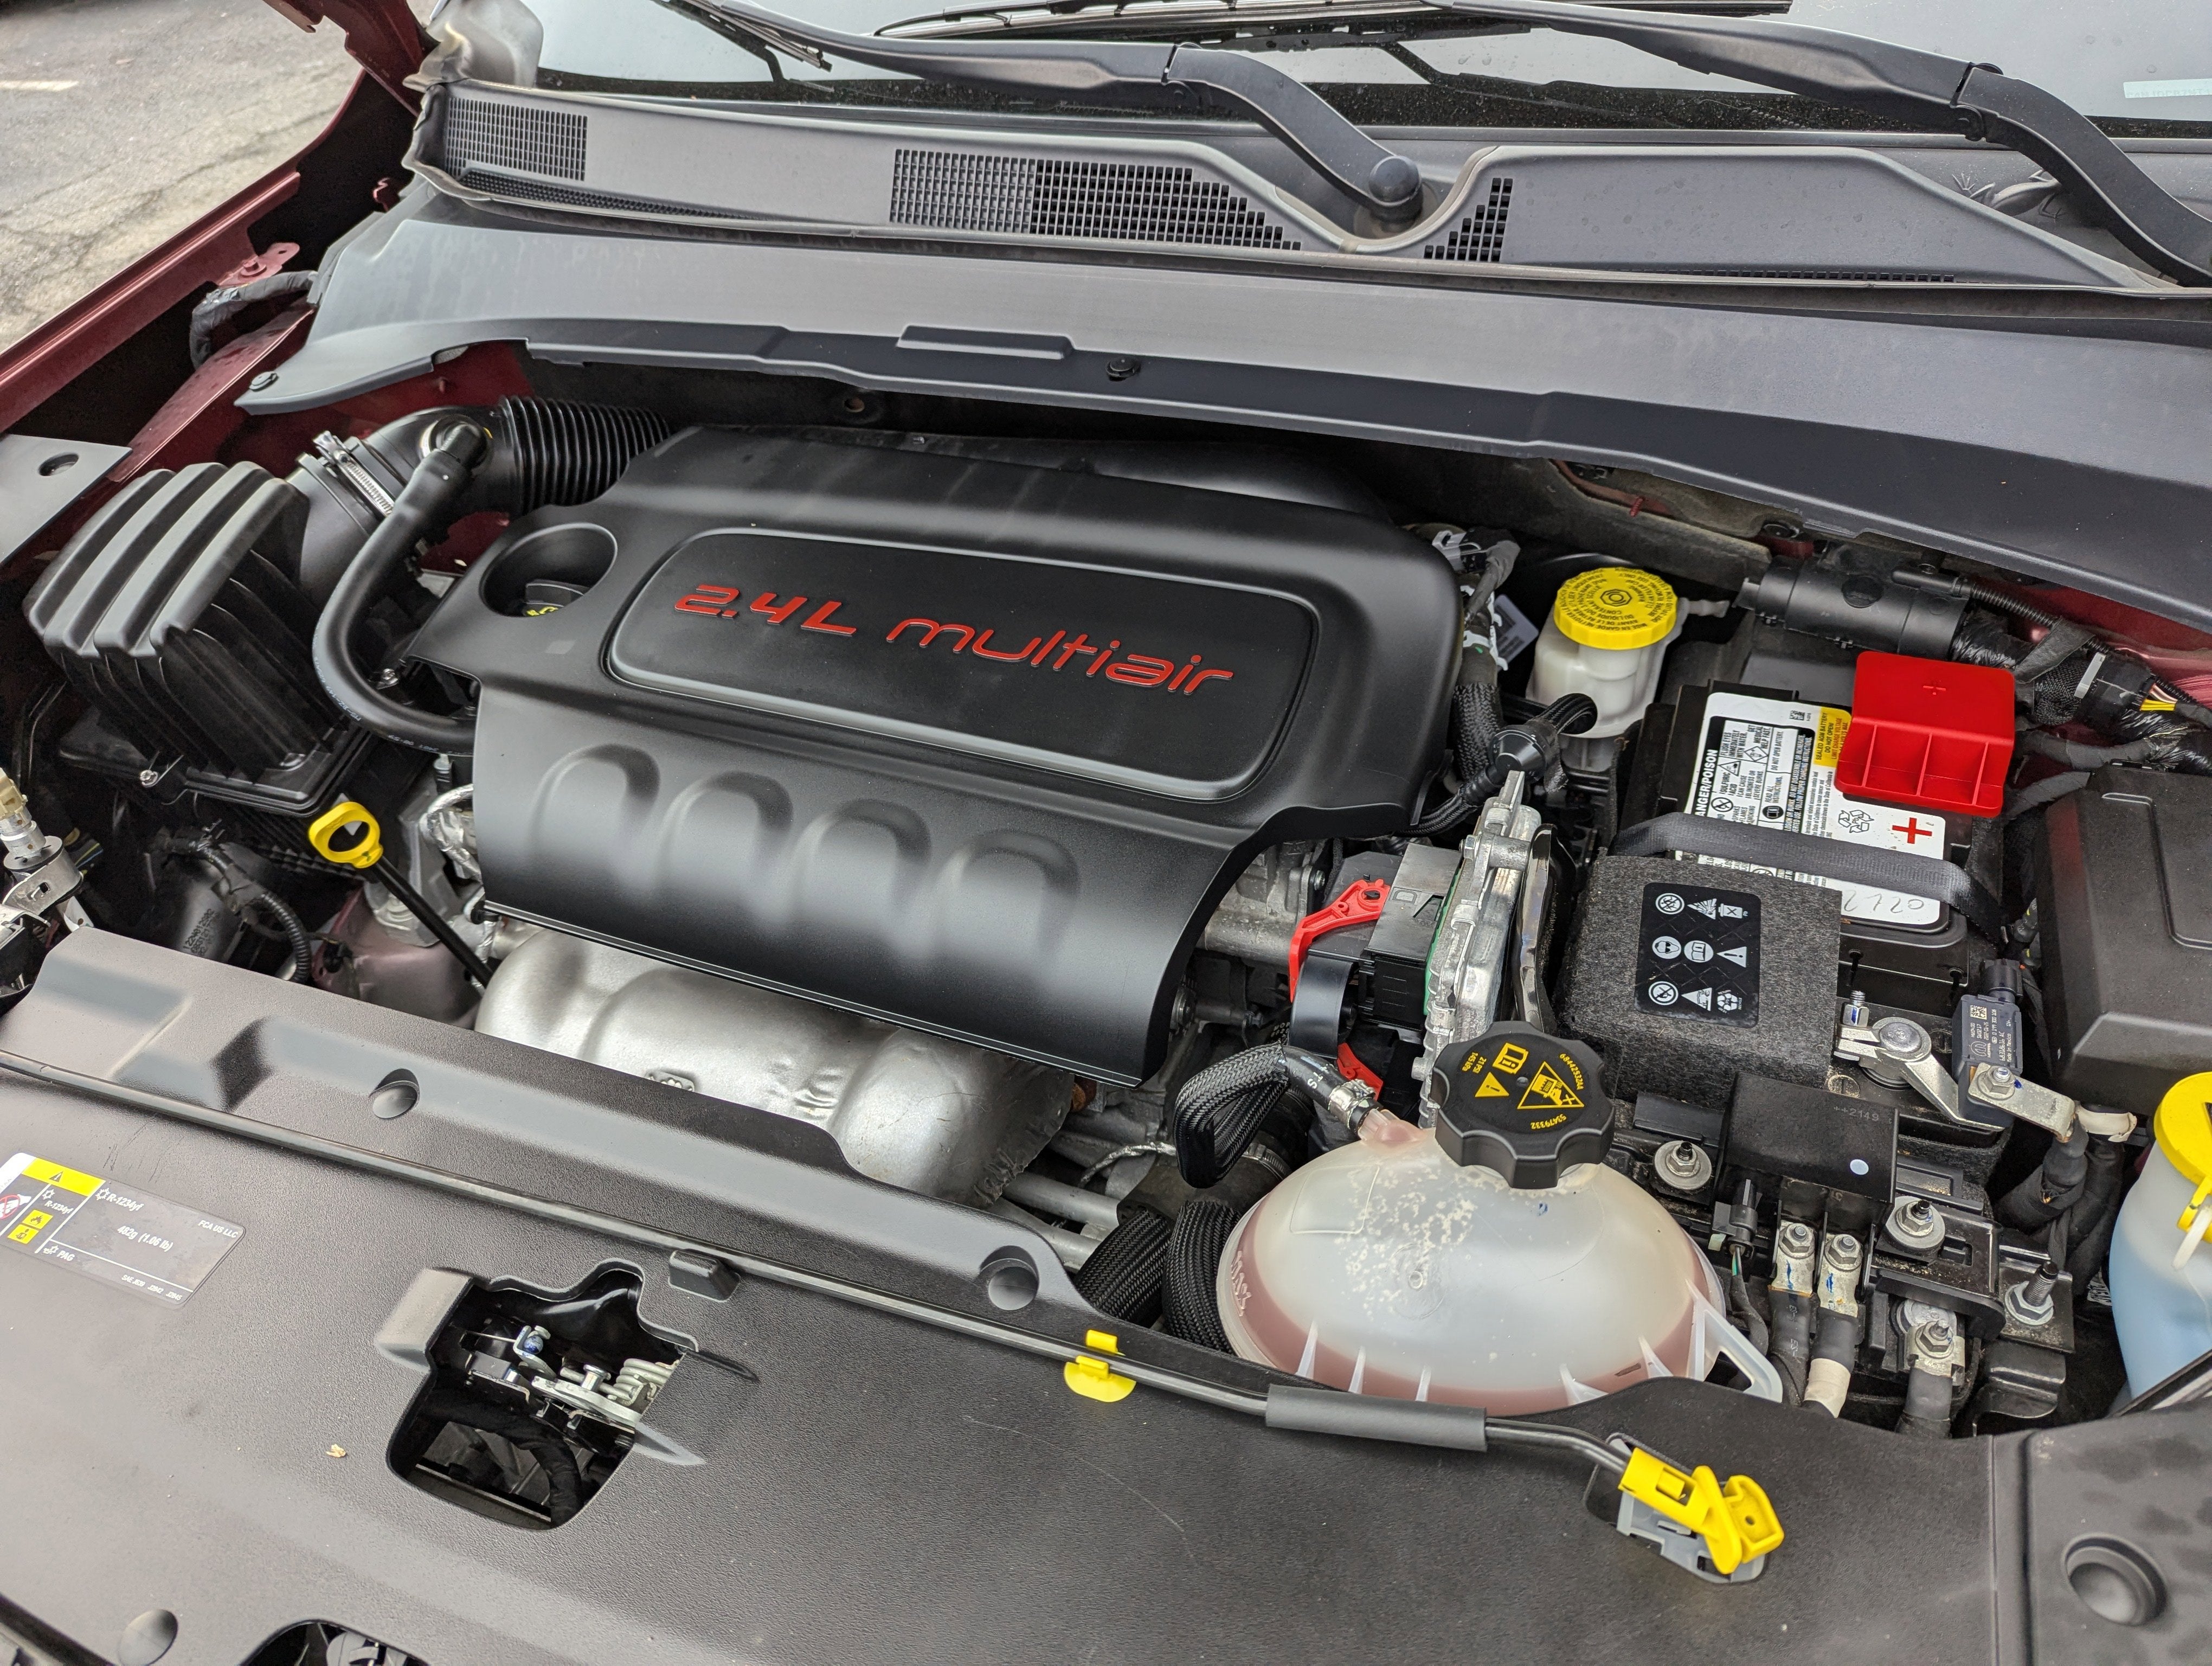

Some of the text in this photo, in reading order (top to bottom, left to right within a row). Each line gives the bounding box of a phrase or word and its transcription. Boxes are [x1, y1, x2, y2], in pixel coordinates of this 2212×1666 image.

[1558, 588, 1568, 607] BOUCHON
[1637, 583, 1652, 595] FILLER
[1643, 596, 1656, 608] CLEAN
[1646, 602, 1665, 617] BEFORE
[1661, 603, 1673, 613] FLUID
[1565, 612, 1595, 627] NETTOYER
[1583, 607, 1597, 616] DOT
[674, 584, 1233, 695] 2.4L multiair
[1720, 732, 1732, 755] FLUSH EYES
[1728, 730, 1740, 757] IMMEDIATELY
[1753, 726, 1763, 744] MEDICAL
[1736, 733, 1747, 758] WITH WATER.
[1792, 760, 1802, 781] DISASSEMBLE
[1799, 762, 1808, 780] CHARGING
[1695, 749, 1718, 816] ANGER/POISON
[1721, 772, 1731, 792] SULFURIC
[1729, 784, 1738, 794] ACID
[1746, 777, 1754, 797] BLINDNESS
[1797, 781, 1806, 794] PROPER
[1796, 795, 1804, 809] FOLLOW
[1732, 806, 1740, 821] SPARKS
[1739, 806, 1748, 822] FLAMES
[1746, 806, 1756, 823] SMOKING
[1462, 1052, 1478, 1072] 145 kPa
[1472, 1056, 1487, 1074] 21 PSI
[44, 1201, 74, 1214] R-1234yf
[106, 1193, 144, 1212] R-1234yf
[198, 1220, 239, 1238] FCA US LLC
[117, 1225, 173, 1252] 482g (1.06 lb)
[57, 1251, 75, 1262] PAG
[121, 1274, 133, 1283] SAE
